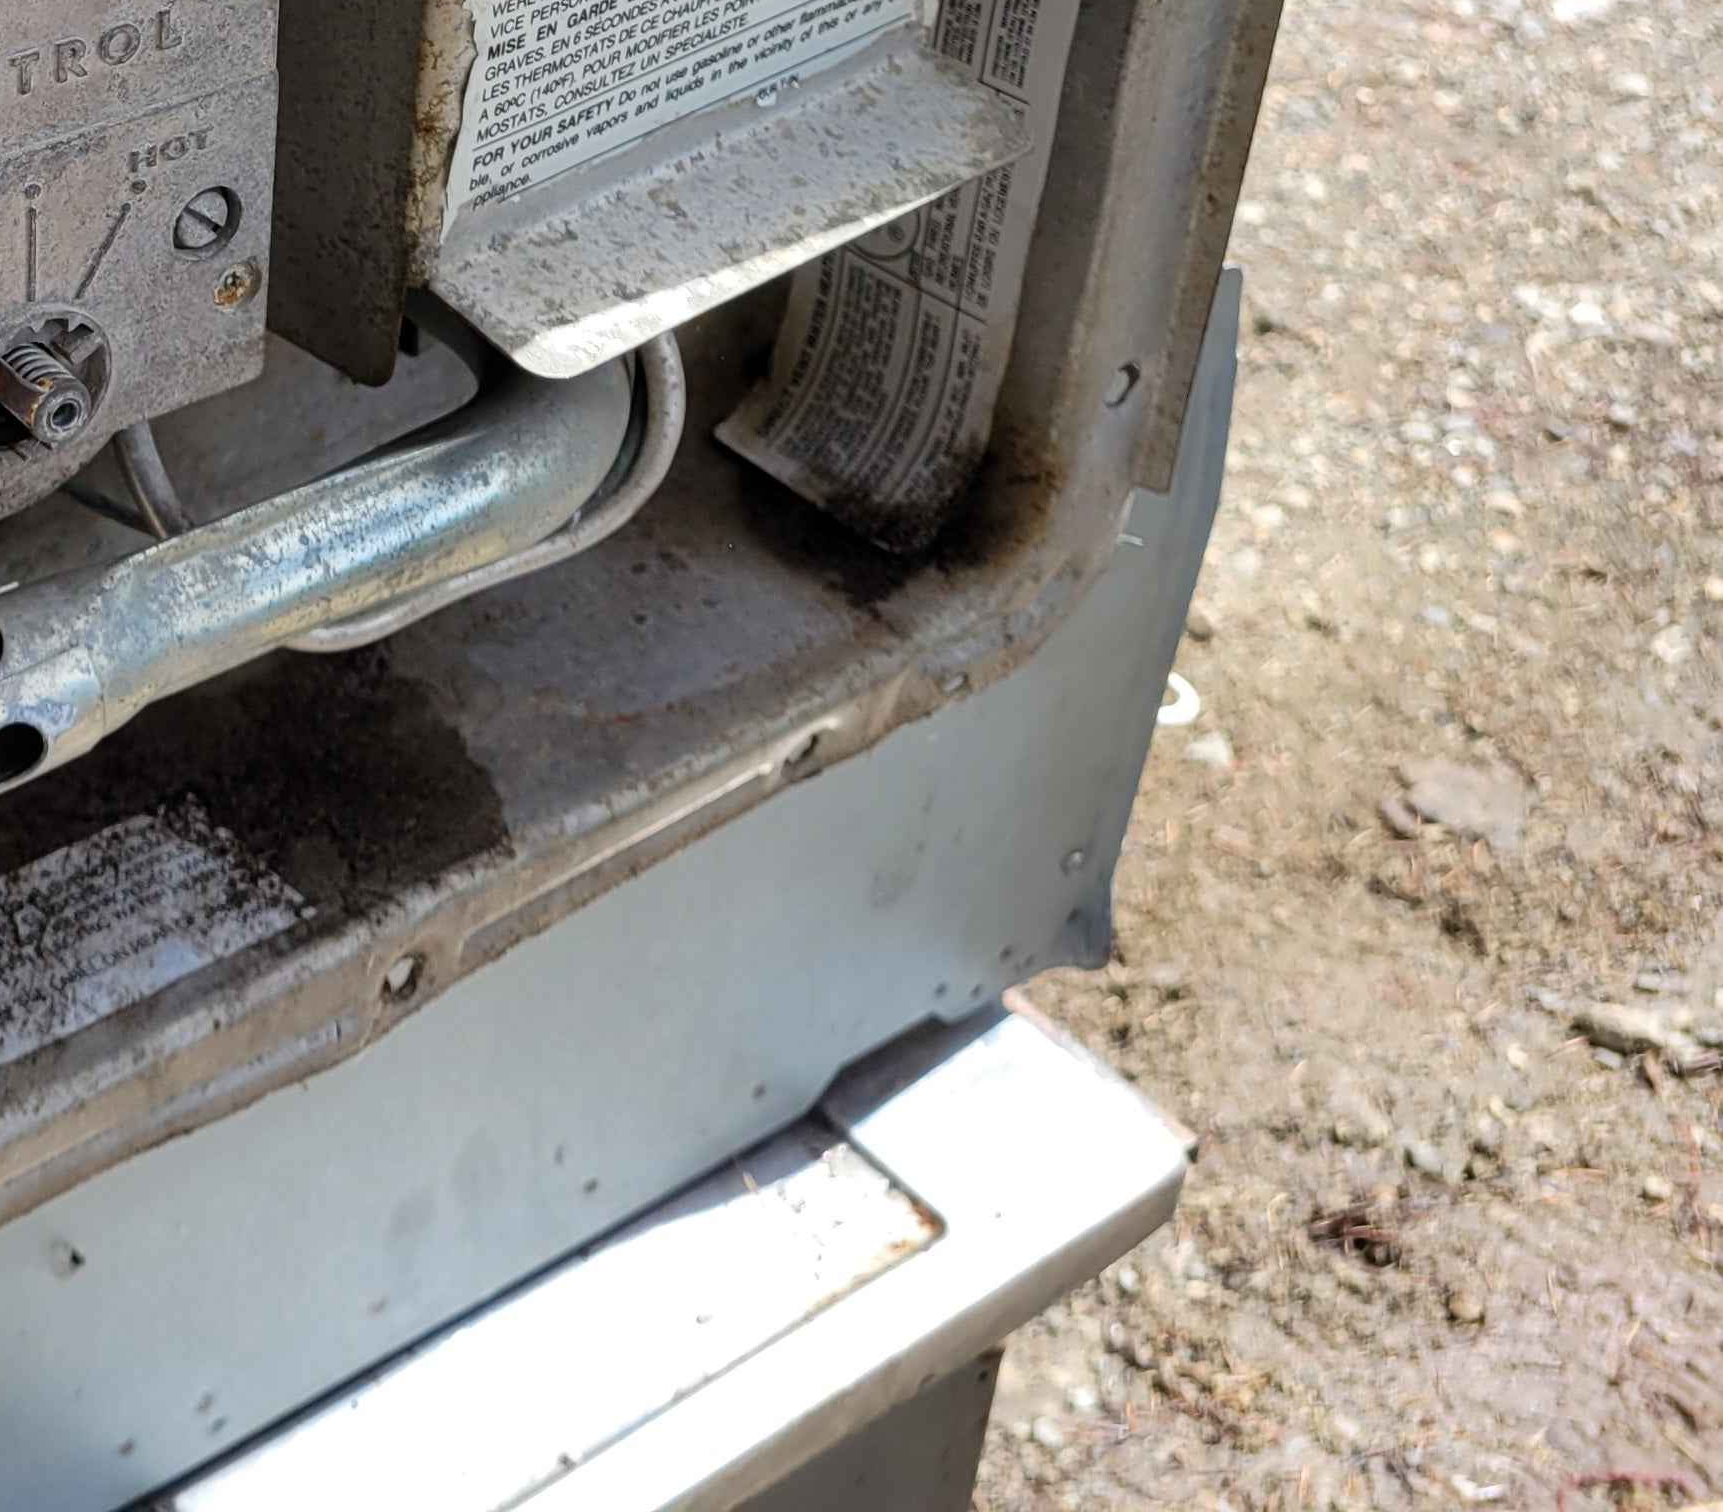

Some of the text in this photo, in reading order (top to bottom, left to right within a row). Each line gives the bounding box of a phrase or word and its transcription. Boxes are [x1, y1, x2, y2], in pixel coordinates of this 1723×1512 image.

[485, 32, 527, 63] MISE
[535, 19, 558, 42] EN
[487, 13, 524, 42] VICE
[551, 32, 571, 54] EN
[582, 49, 622, 78] POUR
[624, 19, 689, 59] MODIFIER
[695, 6, 719, 28] LES
[482, 13, 660, 103] LES THERMOSTATS DE CE
[553, 51, 660, 110] CONSULTEZ UN
[471, 40, 743, 172] FOR YOUR SAFETY Do not use gasoline
[127, 127, 214, 172] HOT
[499, 95, 659, 177] or corrosive and
